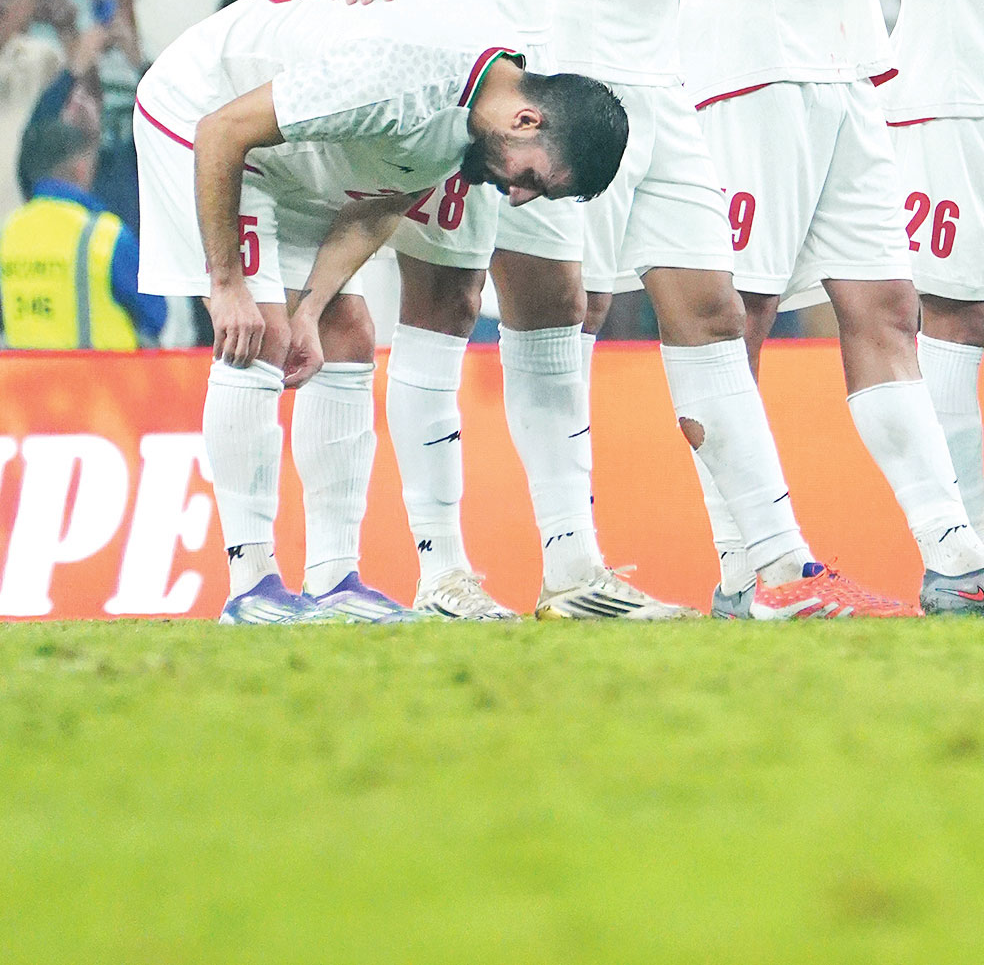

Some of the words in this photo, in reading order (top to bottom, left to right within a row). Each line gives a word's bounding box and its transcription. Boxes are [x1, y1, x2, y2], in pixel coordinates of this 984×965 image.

[237, 215, 260, 276] 5
[721, 188, 756, 252] 9
[903, 191, 960, 259] 26
[0, 433, 214, 615] PE
